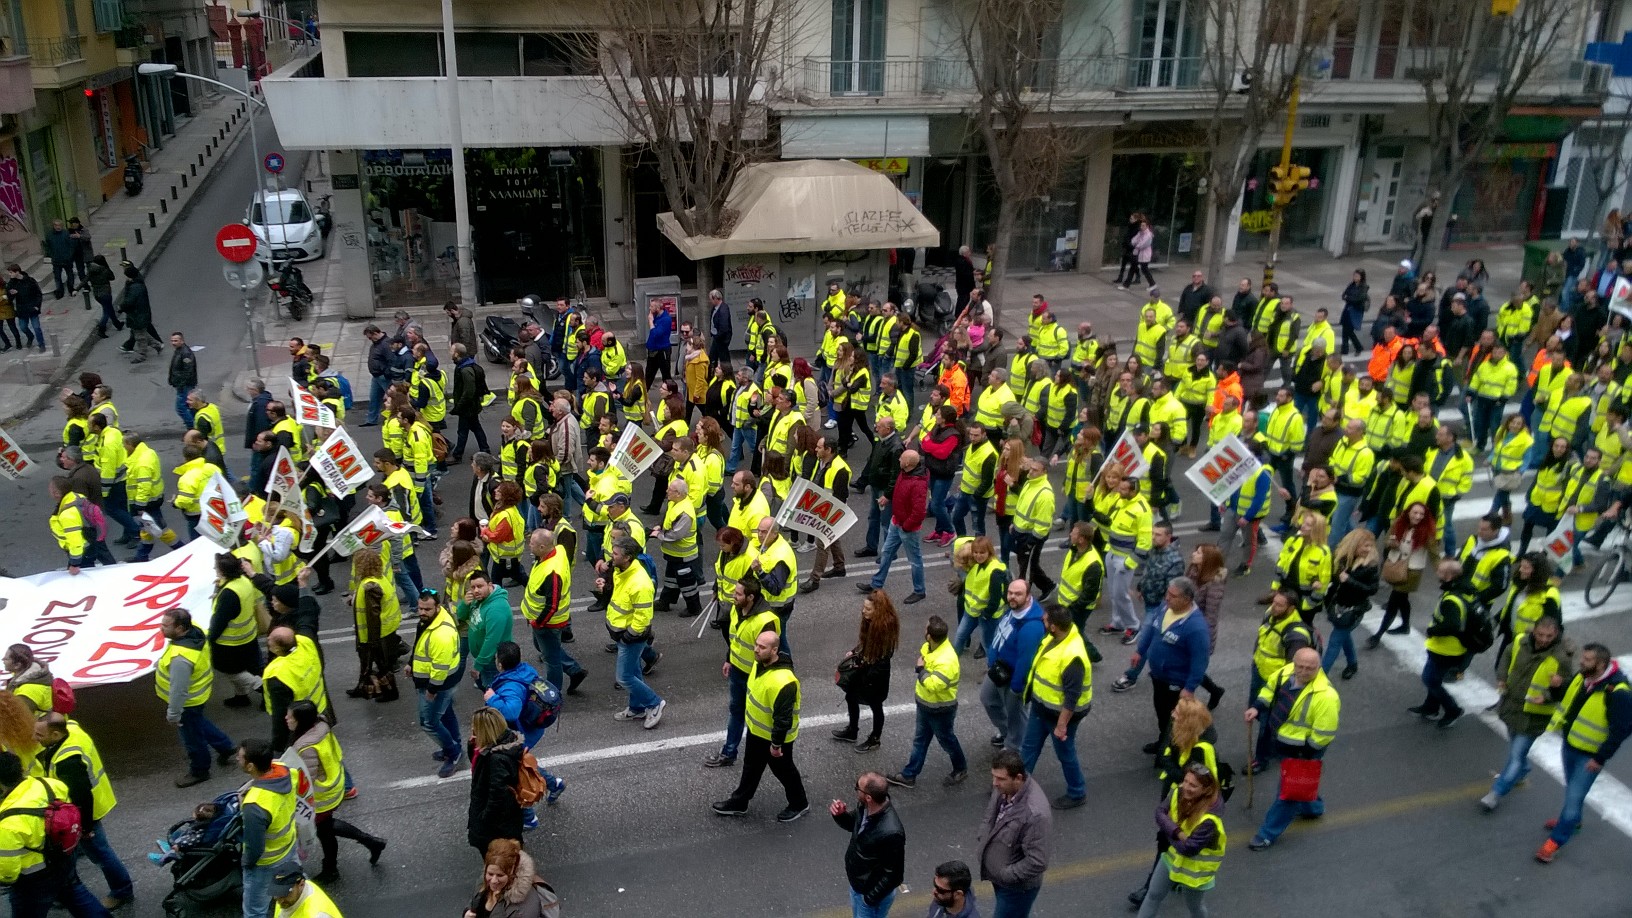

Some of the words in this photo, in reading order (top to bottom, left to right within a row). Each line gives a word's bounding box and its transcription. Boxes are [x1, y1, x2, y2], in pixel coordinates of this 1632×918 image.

[364, 163, 467, 176] ΟΡΘΟΠΑΙΔΙΚ
[493, 167, 539, 176] ΕΓΝΑΤΙΑ
[506, 178, 527, 186] 101
[489, 188, 549, 199] ΧΛΑΜΙΔΗΣ
[278, 457, 296, 488] ΝΑ
[326, 438, 363, 480] ΝΑΙ
[1199, 445, 1243, 485] ΝΑΙ
[795, 488, 846, 527] ΝΑΙ
[794, 512, 836, 542] ΜΕΤΑΛΛΕΙΑ
